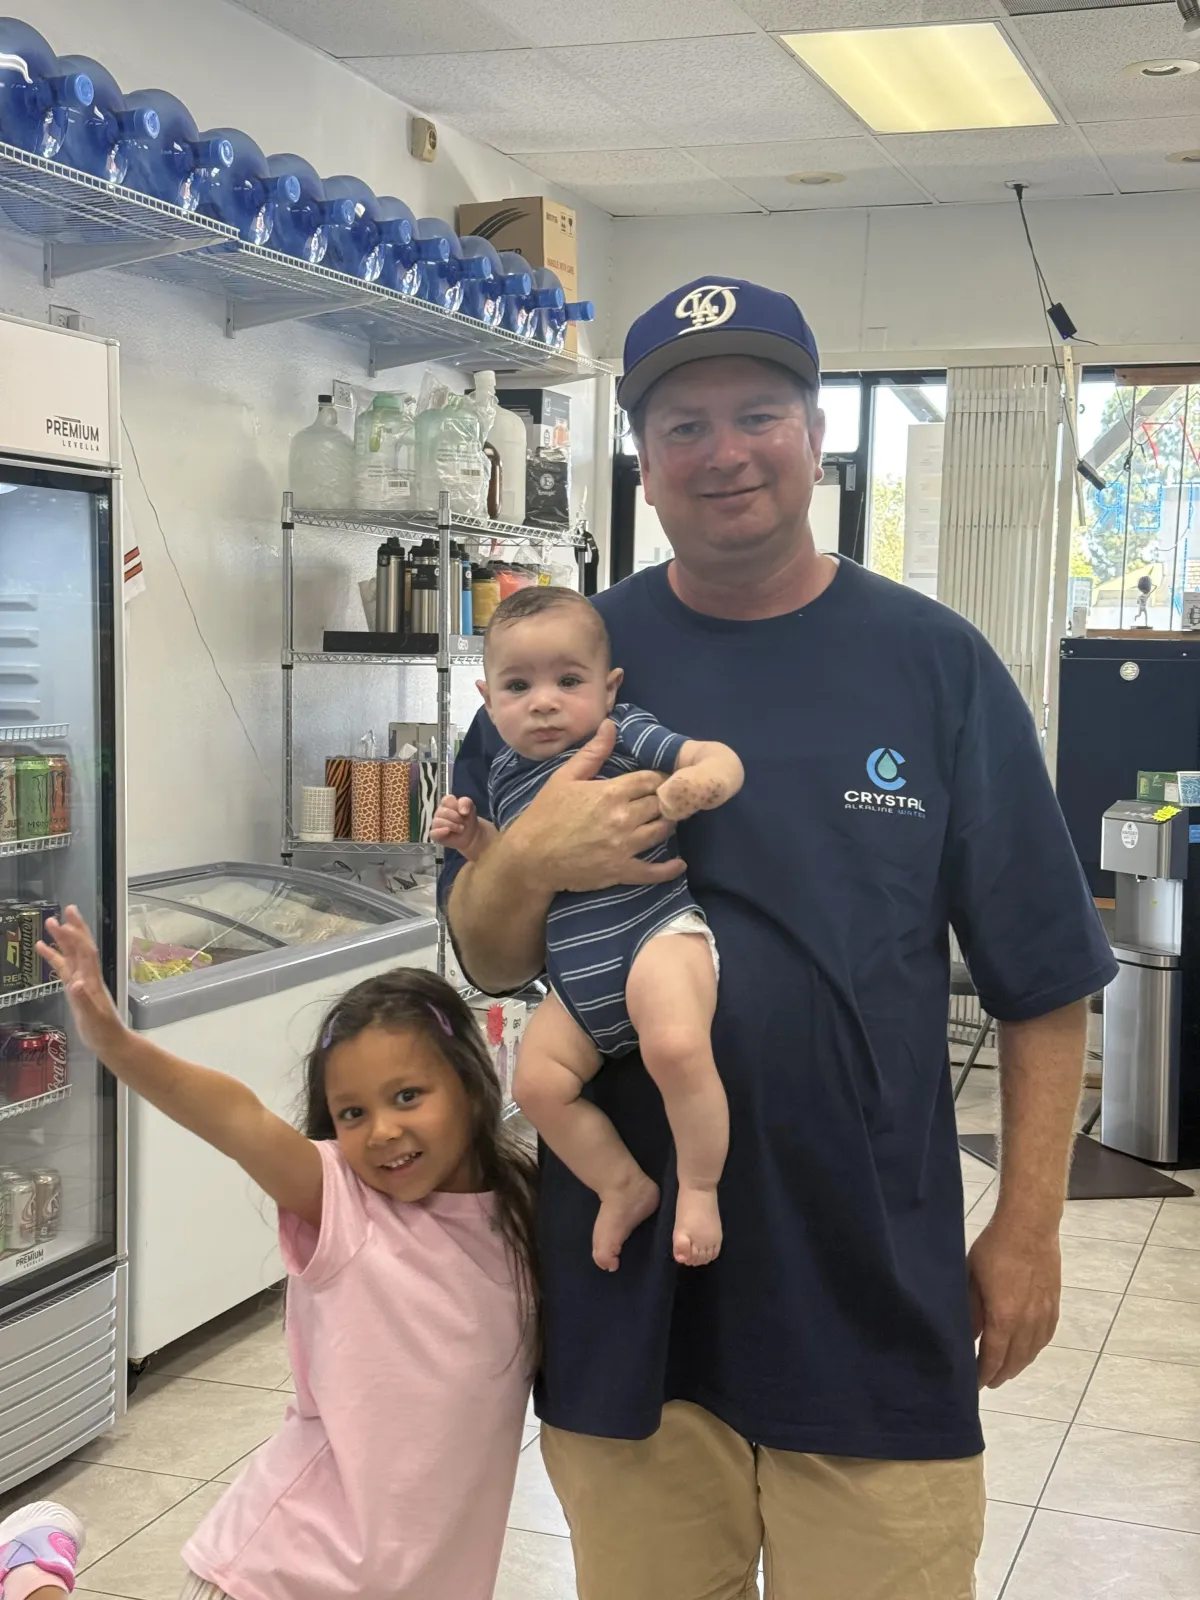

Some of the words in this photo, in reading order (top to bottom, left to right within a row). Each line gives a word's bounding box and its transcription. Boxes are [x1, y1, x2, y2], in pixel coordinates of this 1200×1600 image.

[46, 418, 100, 442] PREMIUM
[62, 439, 100, 452] LEVELLA
[843, 790, 926, 812] CRYSTAL
[844, 803, 894, 814] ALKALINE
[16, 1249, 44, 1267] PREMIUM
